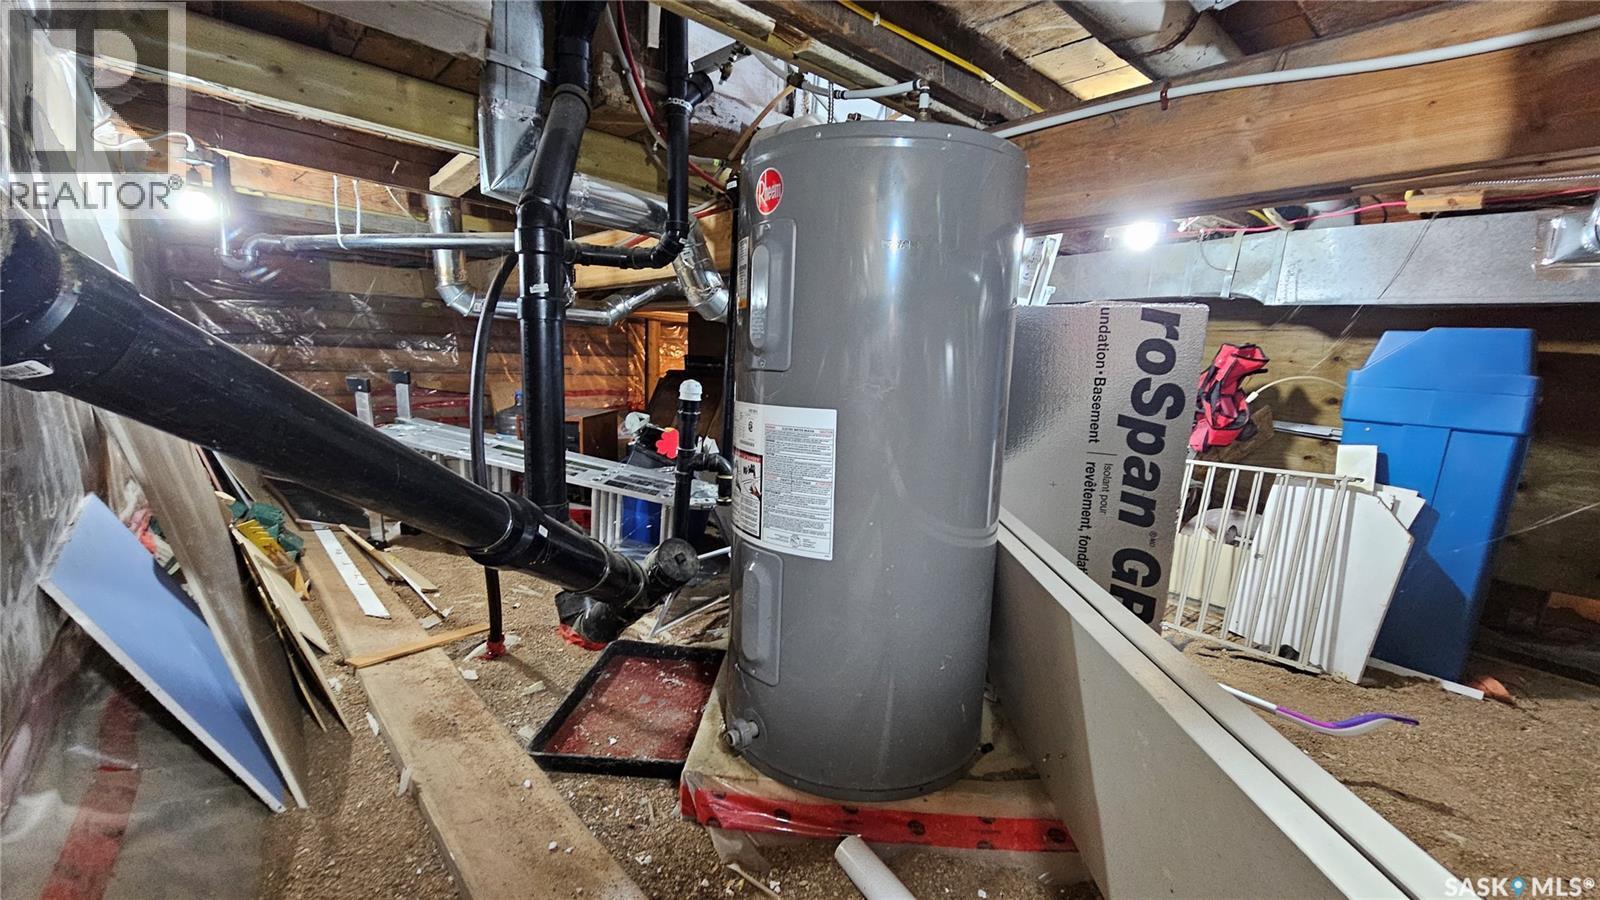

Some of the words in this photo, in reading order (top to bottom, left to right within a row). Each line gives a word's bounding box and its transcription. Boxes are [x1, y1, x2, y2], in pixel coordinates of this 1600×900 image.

[759, 172, 781, 208] Rheem
[1095, 307, 1111, 369] undation
[1088, 377, 1107, 444] Basement
[1117, 307, 1186, 528] roSpan
[1078, 461, 1097, 532] revêtement,
[1100, 462, 1114, 493] Isolant
[1099, 494, 1108, 515] pour
[1076, 535, 1091, 575] fondat
